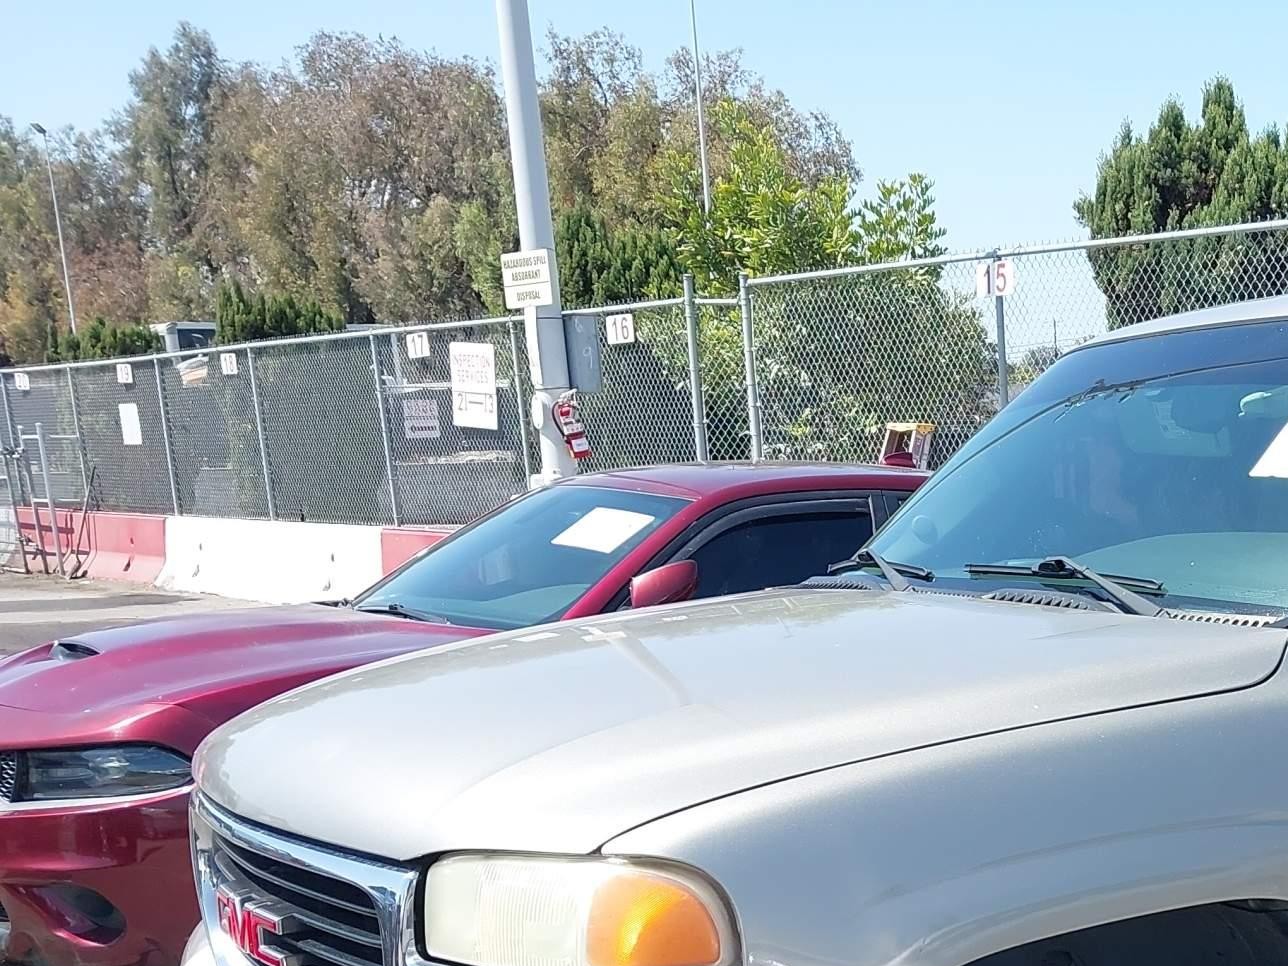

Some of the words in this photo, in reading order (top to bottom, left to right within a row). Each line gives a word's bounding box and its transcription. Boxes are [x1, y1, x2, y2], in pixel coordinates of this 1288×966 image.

[984, 256, 1007, 295] 15
[516, 288, 541, 302] DISPOSAL
[611, 316, 630, 341] 16
[411, 334, 425, 356] 17
[119, 365, 130, 382] 19
[223, 354, 235, 373] 18
